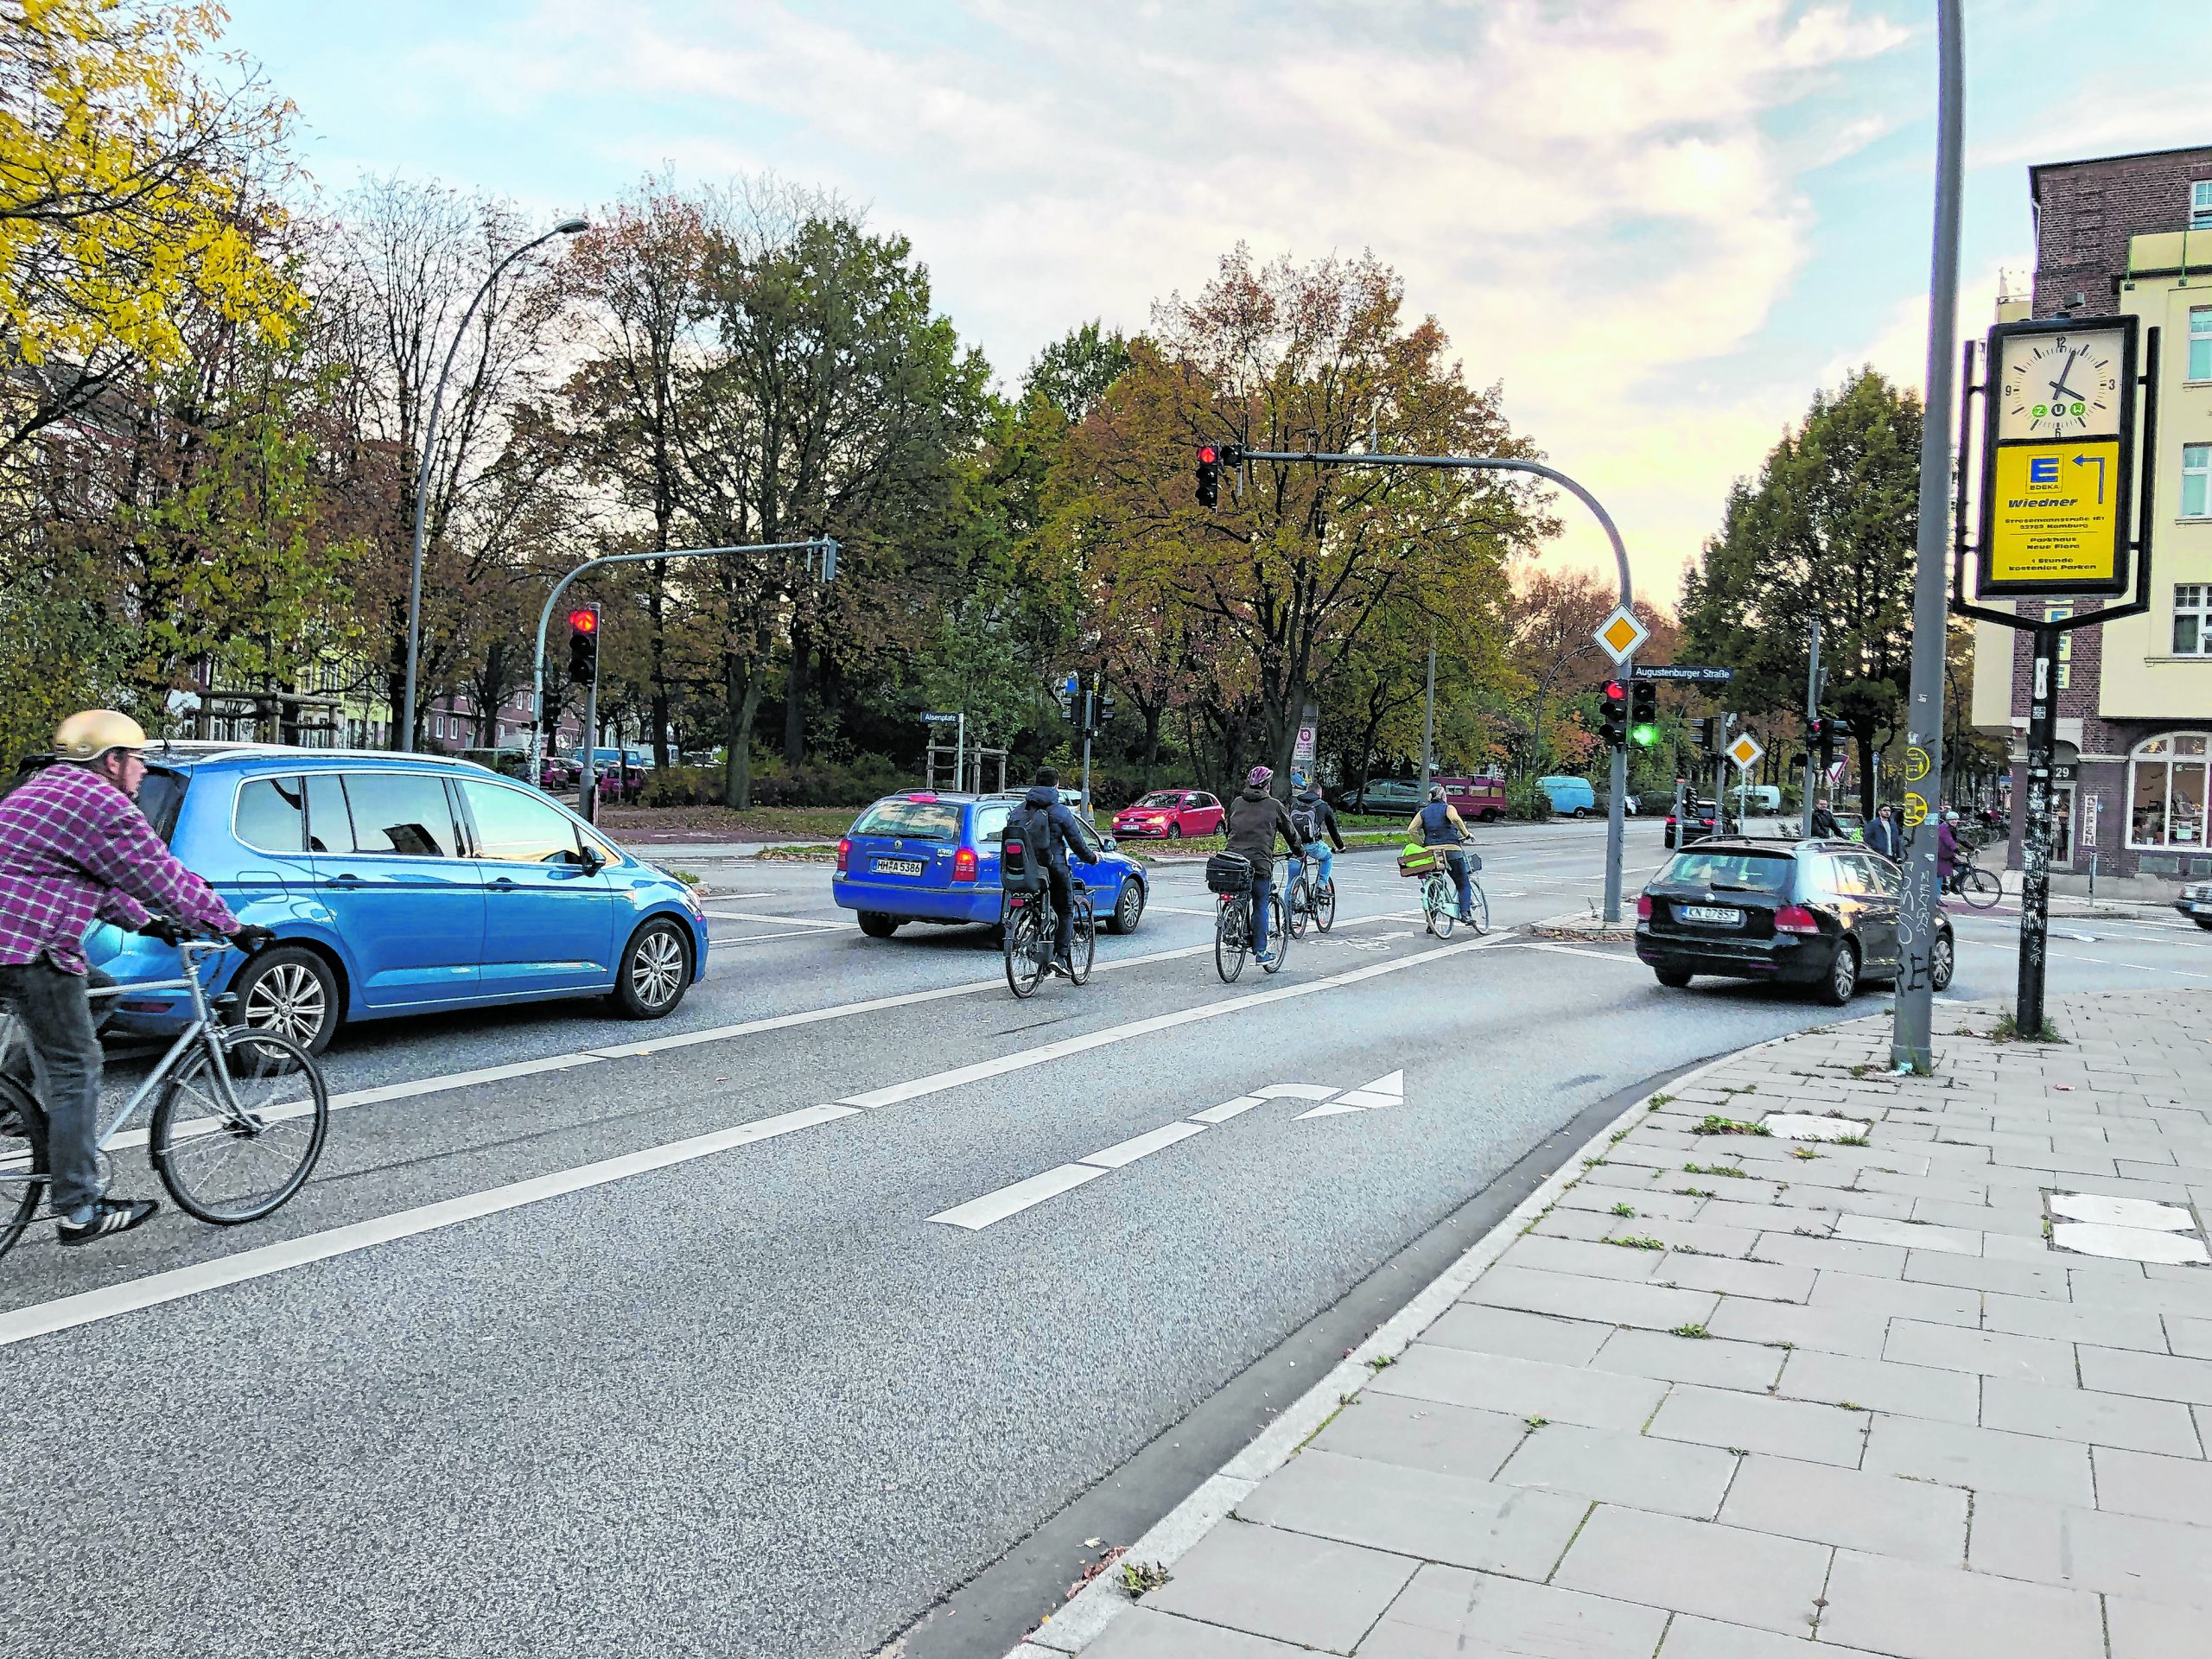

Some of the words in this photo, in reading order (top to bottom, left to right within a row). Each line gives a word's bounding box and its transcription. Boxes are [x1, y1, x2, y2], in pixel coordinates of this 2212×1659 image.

[2056, 336, 2066, 347] 12
[2108, 379, 2116, 390] 3
[2005, 385, 2012, 396] 9
[2055, 428, 2062, 438] 6
[2031, 458, 2059, 483] E
[2008, 498, 2079, 508] Wiedner
[1636, 667, 1700, 679] Augustenburger
[1703, 669, 1730, 679] Straße
[925, 713, 957, 722] Alsenplatz
[2055, 767, 2069, 778] 29
[877, 859, 888, 870] HH
[899, 862, 920, 873] 5386
